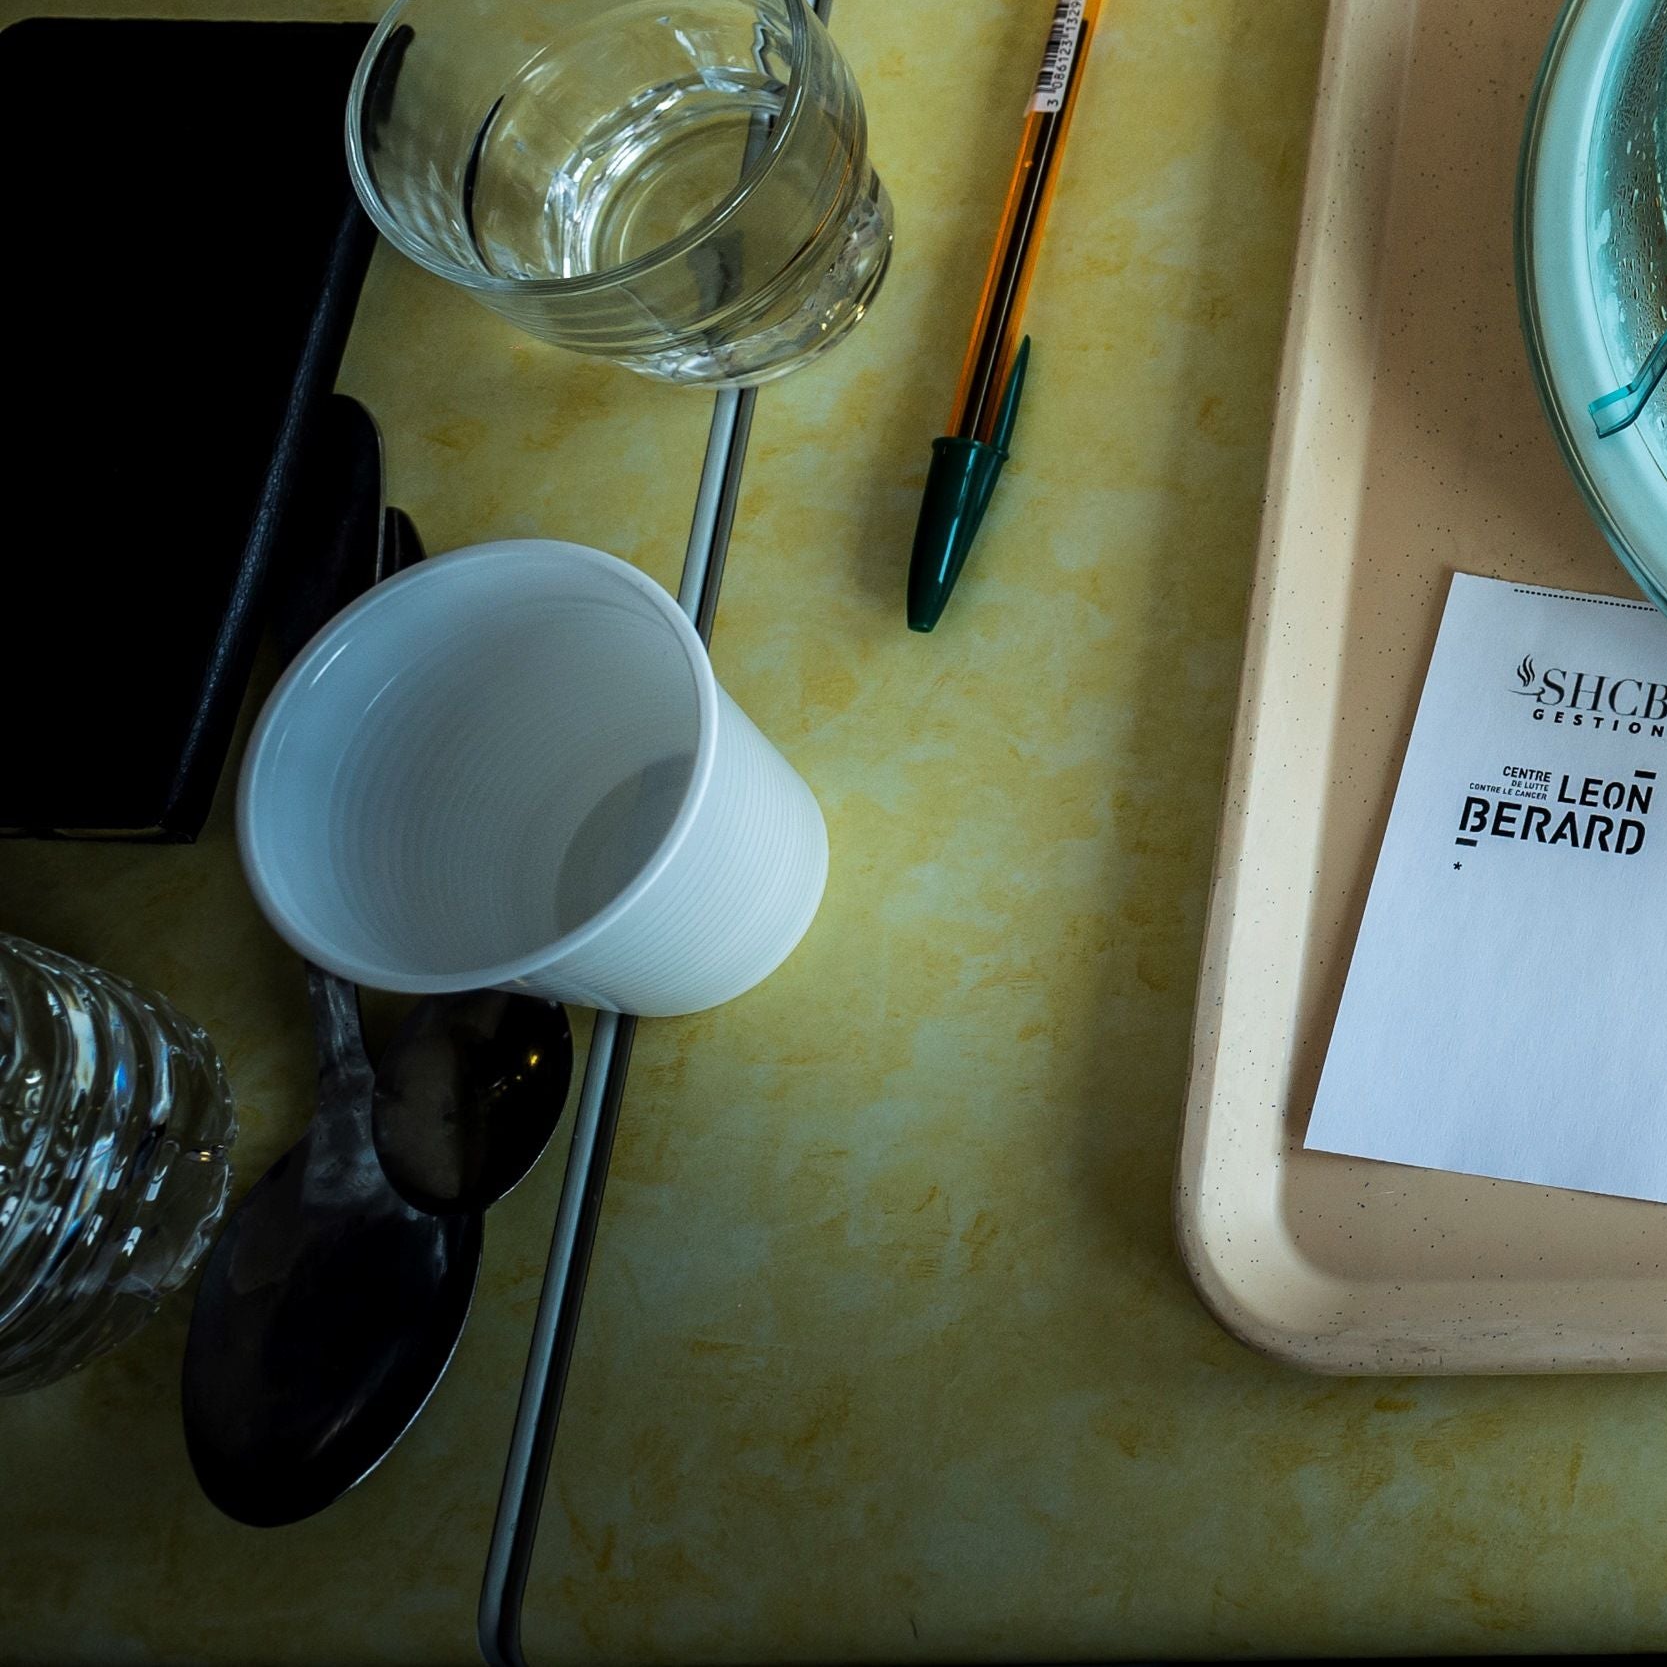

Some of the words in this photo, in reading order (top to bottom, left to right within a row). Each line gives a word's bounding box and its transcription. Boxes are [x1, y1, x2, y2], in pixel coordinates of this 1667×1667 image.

[1532, 708, 1665, 738] GESTION
[1502, 765, 1552, 783] CENTRE
[1511, 779, 1523, 788] DE
[1524, 781, 1549, 792] LUTTE
[1469, 782, 1501, 795] CONTRE
[1502, 787, 1513, 796] LE
[1514, 790, 1547, 800] CANCER
[1557, 774, 1654, 815] LEON
[1458, 796, 1647, 855] BERARD
